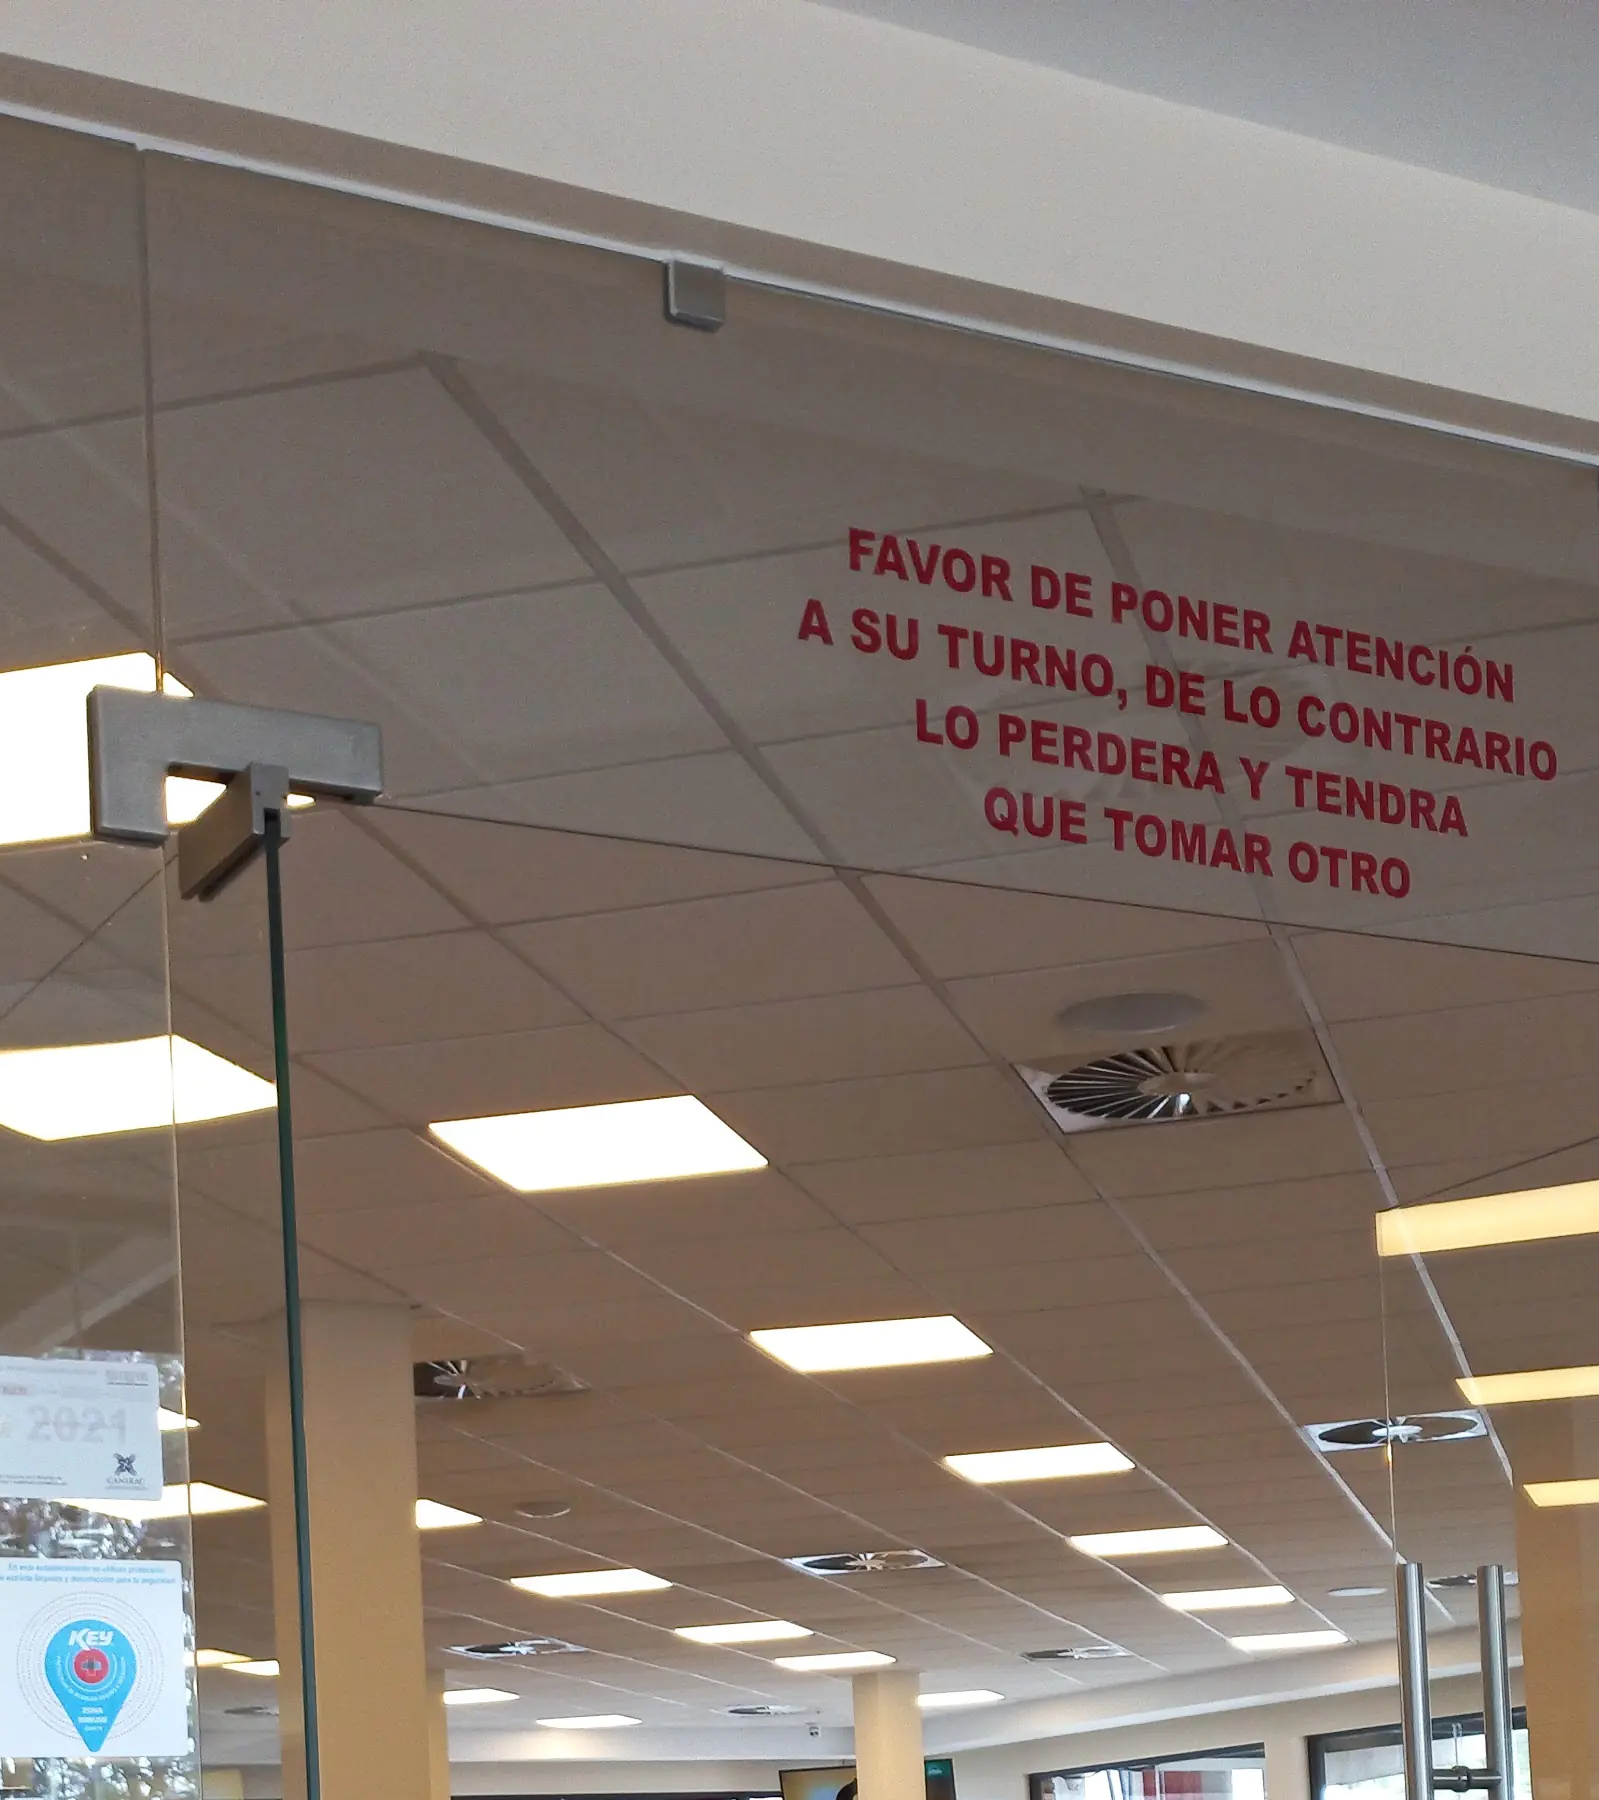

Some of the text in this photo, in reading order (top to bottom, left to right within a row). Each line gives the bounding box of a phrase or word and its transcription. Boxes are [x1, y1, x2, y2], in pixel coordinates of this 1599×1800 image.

[848, 526, 1514, 702] FAVOR DE PONER ATENCIÓN
[798, 599, 1557, 781] A SU TURNO, DE LO CONTRARIO
[914, 698, 1469, 837] LO PERDERA Y TENDRA
[983, 786, 1411, 900] QUE TOMAR OTRO
[26, 1405, 127, 1444] 2021
[68, 1628, 114, 1650] KEY
